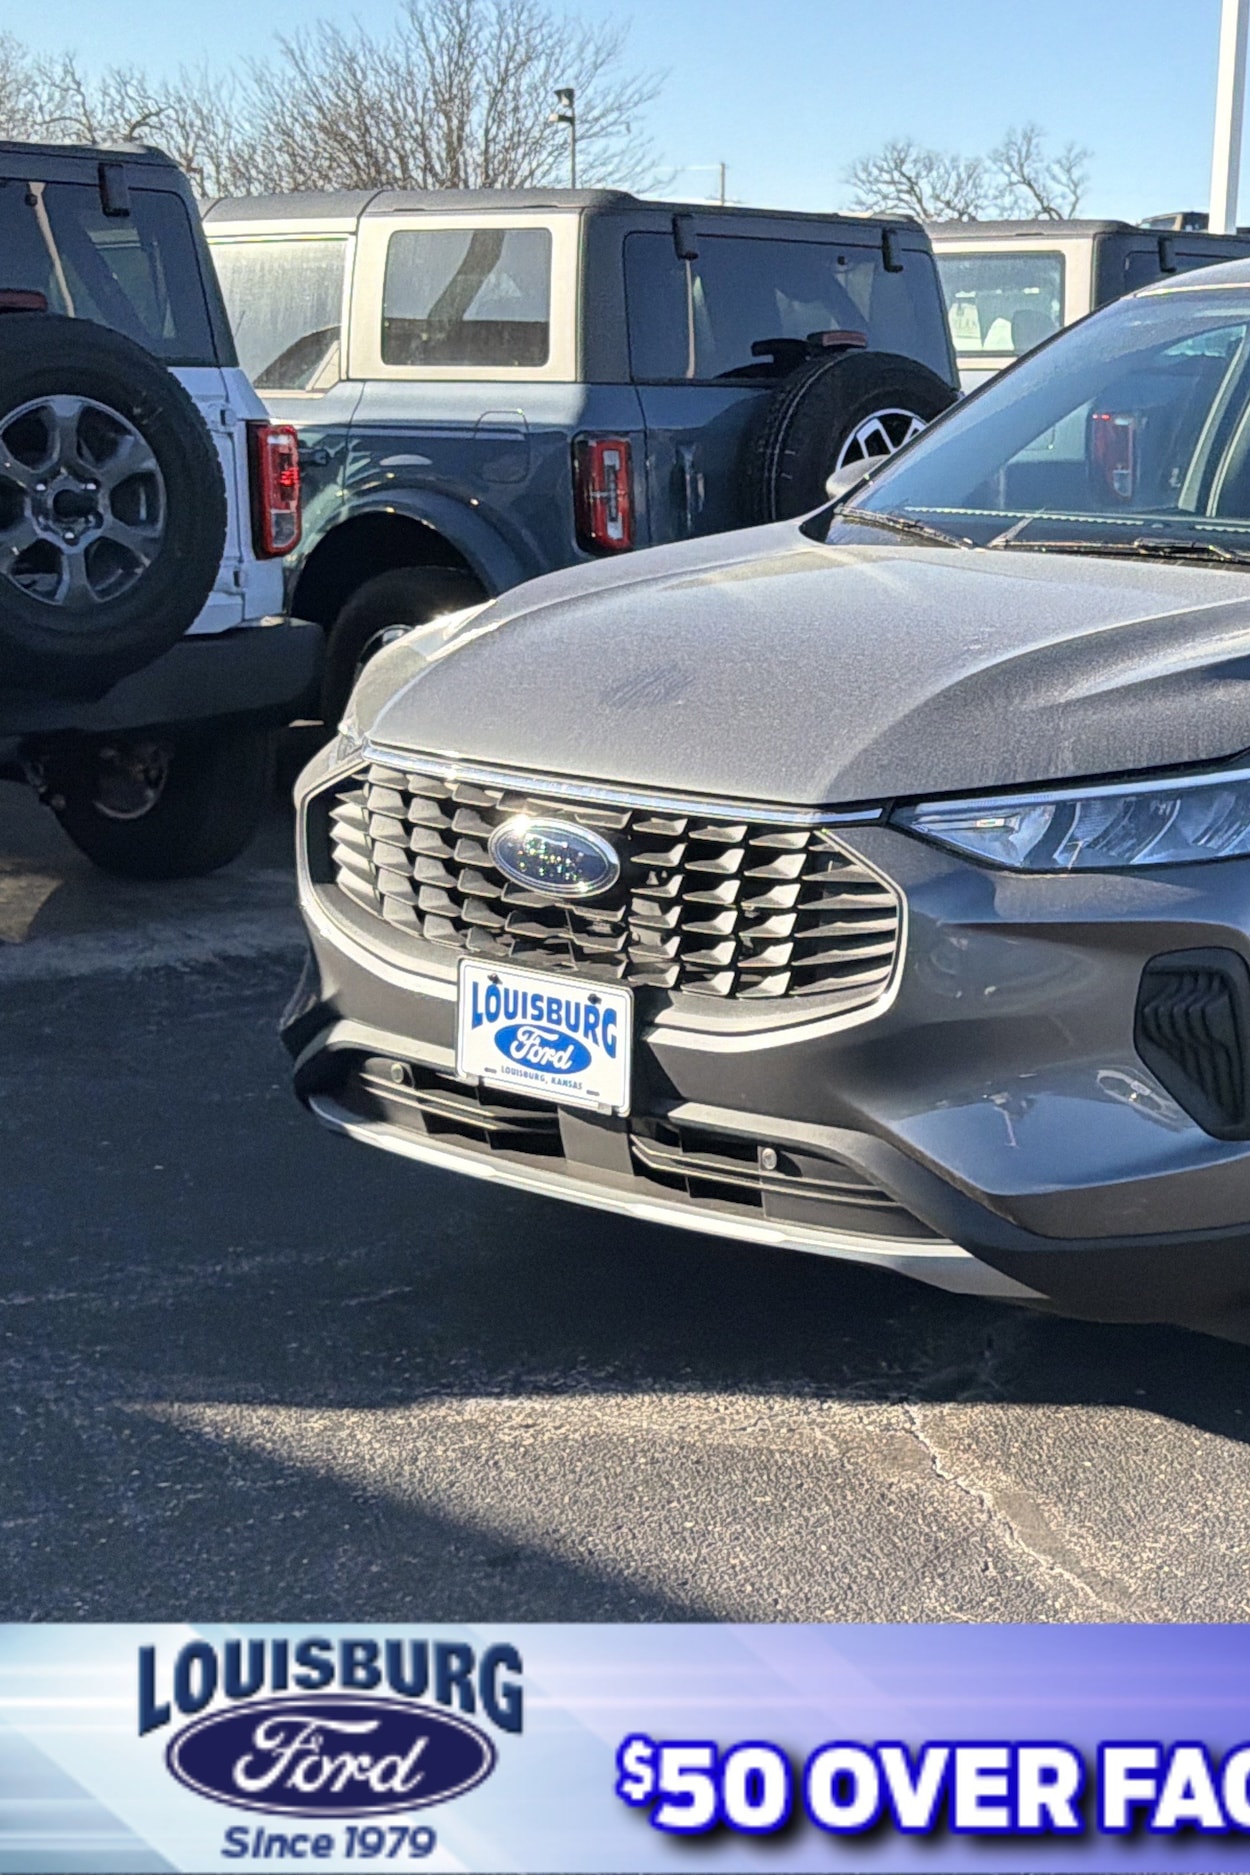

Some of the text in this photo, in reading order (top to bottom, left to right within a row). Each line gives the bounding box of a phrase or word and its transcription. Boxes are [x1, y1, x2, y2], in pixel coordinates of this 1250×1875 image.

[472, 981, 617, 1059] LOUISBURG
[510, 1025, 575, 1070] Ford
[500, 1064, 583, 1090] LOUISBURG, KANSAS
